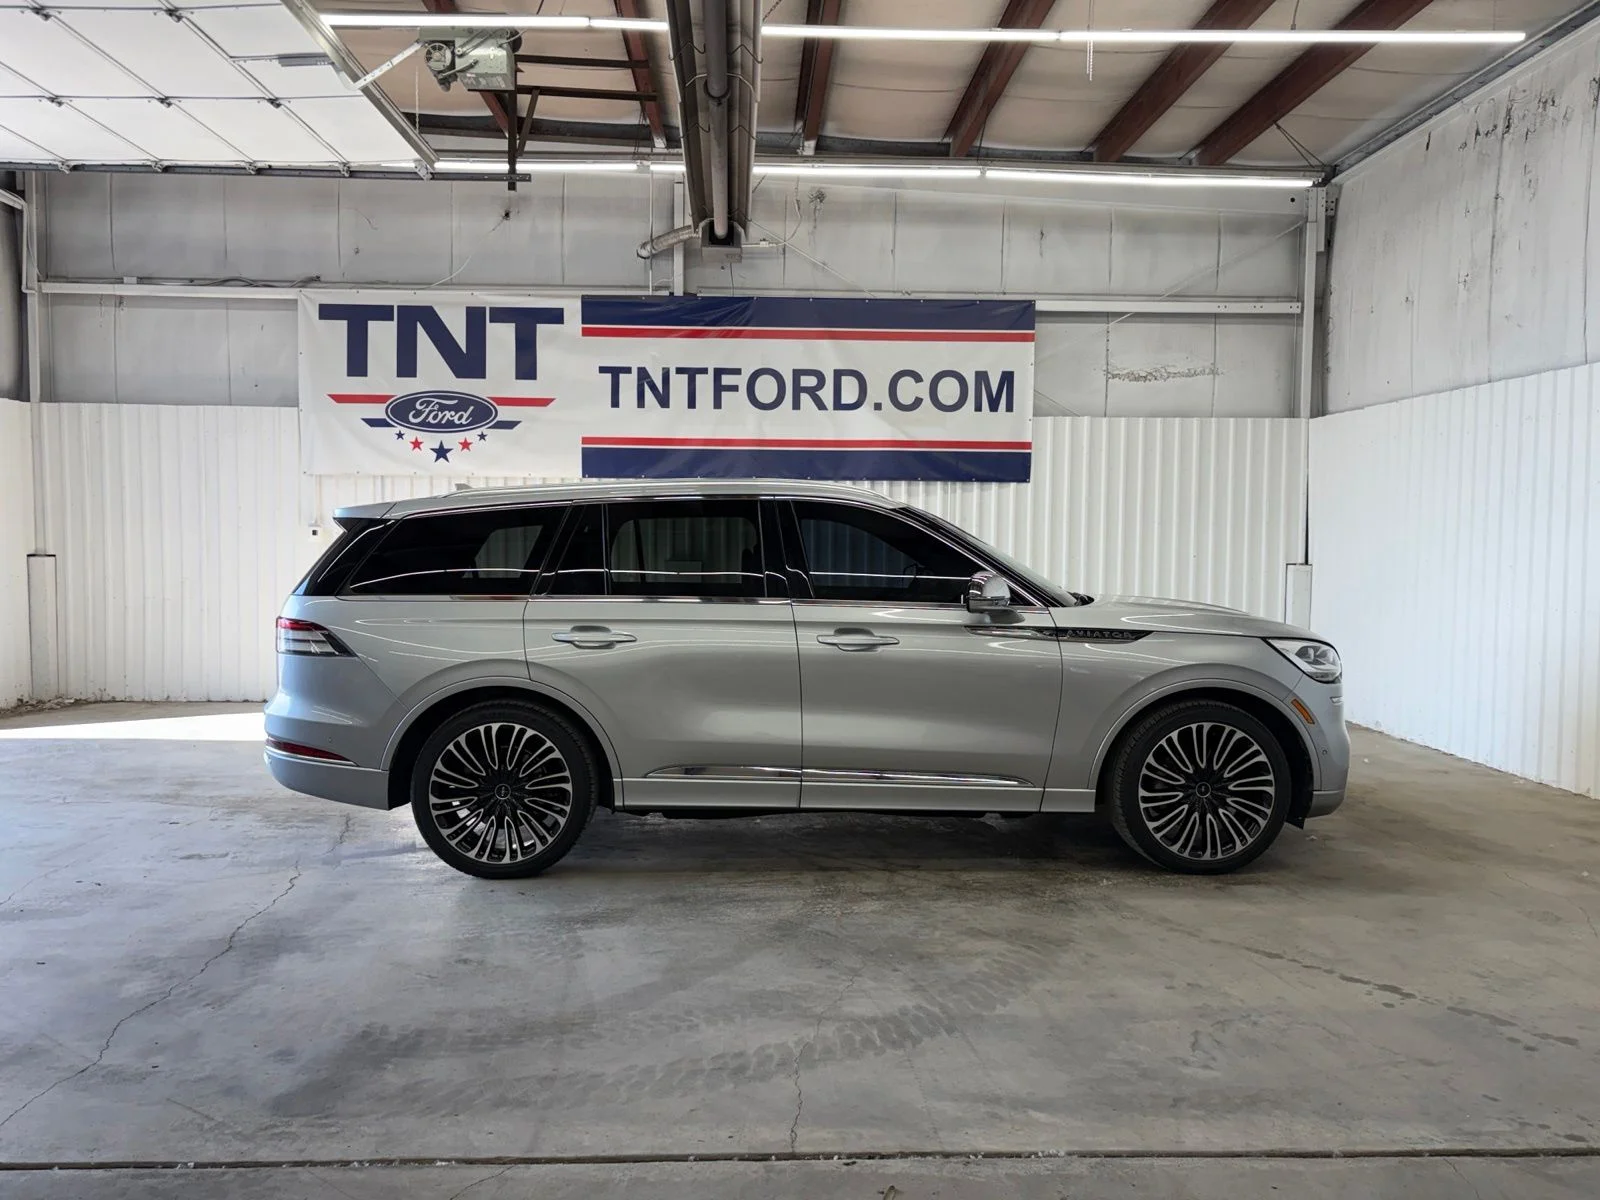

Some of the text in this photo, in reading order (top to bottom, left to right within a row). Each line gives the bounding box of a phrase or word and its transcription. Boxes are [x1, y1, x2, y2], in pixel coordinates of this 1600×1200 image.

[319, 304, 564, 381] TNT
[598, 365, 1015, 413] TNTFORD.COM
[408, 397, 474, 425] Ford
[1067, 629, 1133, 639] AVIATOR
